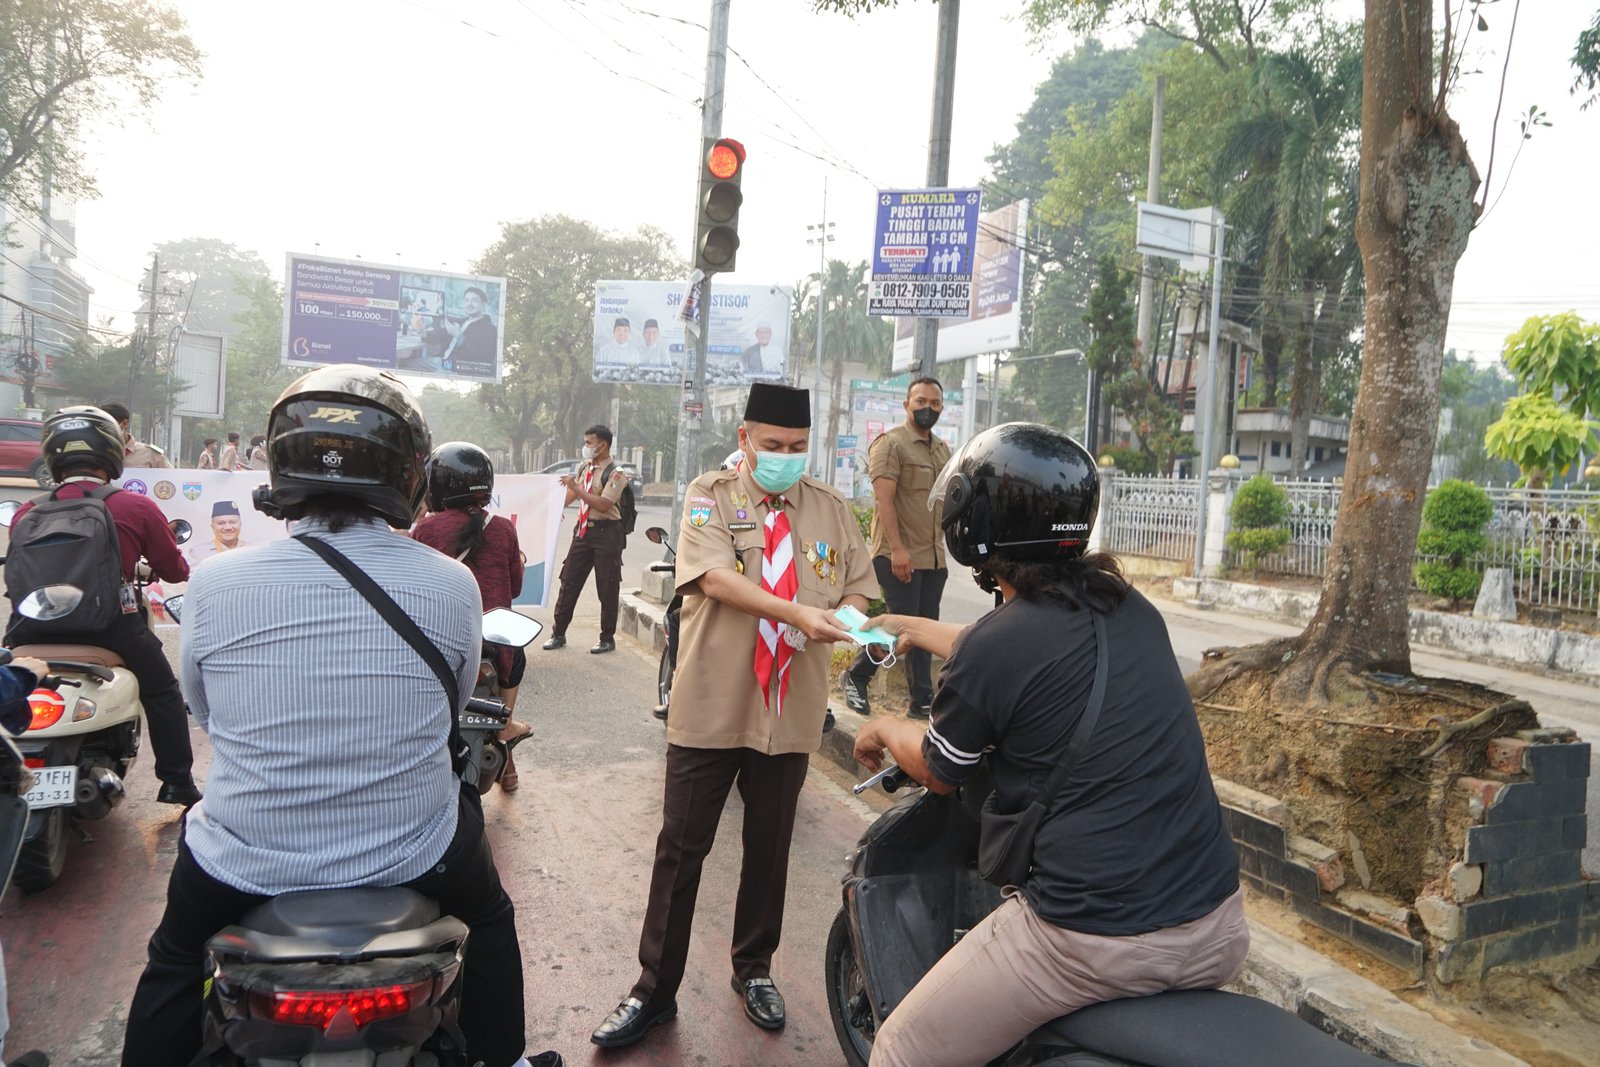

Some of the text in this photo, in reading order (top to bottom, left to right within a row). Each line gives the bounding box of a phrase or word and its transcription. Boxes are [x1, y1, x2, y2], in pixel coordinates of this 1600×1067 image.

[901, 192, 956, 205] KUMARA
[890, 205, 966, 219] PUSAT TERAPI
[888, 218, 965, 232] TINGGI BADAN
[883, 232, 968, 245] TAMBAH 1-8 CM
[883, 248, 926, 256] TERBUKTI
[297, 263, 391, 280] #PakeBiznet Selalu Senang
[297, 271, 375, 287] Bandwidth Besar untuk
[296, 280, 321, 289] Semua
[321, 282, 352, 293] Aktivitas
[883, 283, 970, 298] 0812-7909-0505
[299, 303, 319, 314] 100
[600, 306, 623, 314] Terbuka
[872, 299, 968, 309] JL. RAYA PASAR AUR DURI INDAH
[346, 310, 381, 321] 150,000
[311, 342, 332, 350] Biznet
[308, 407, 363, 423] JPX
[322, 455, 343, 465] DOT
[1051, 523, 1089, 531] HONDA
